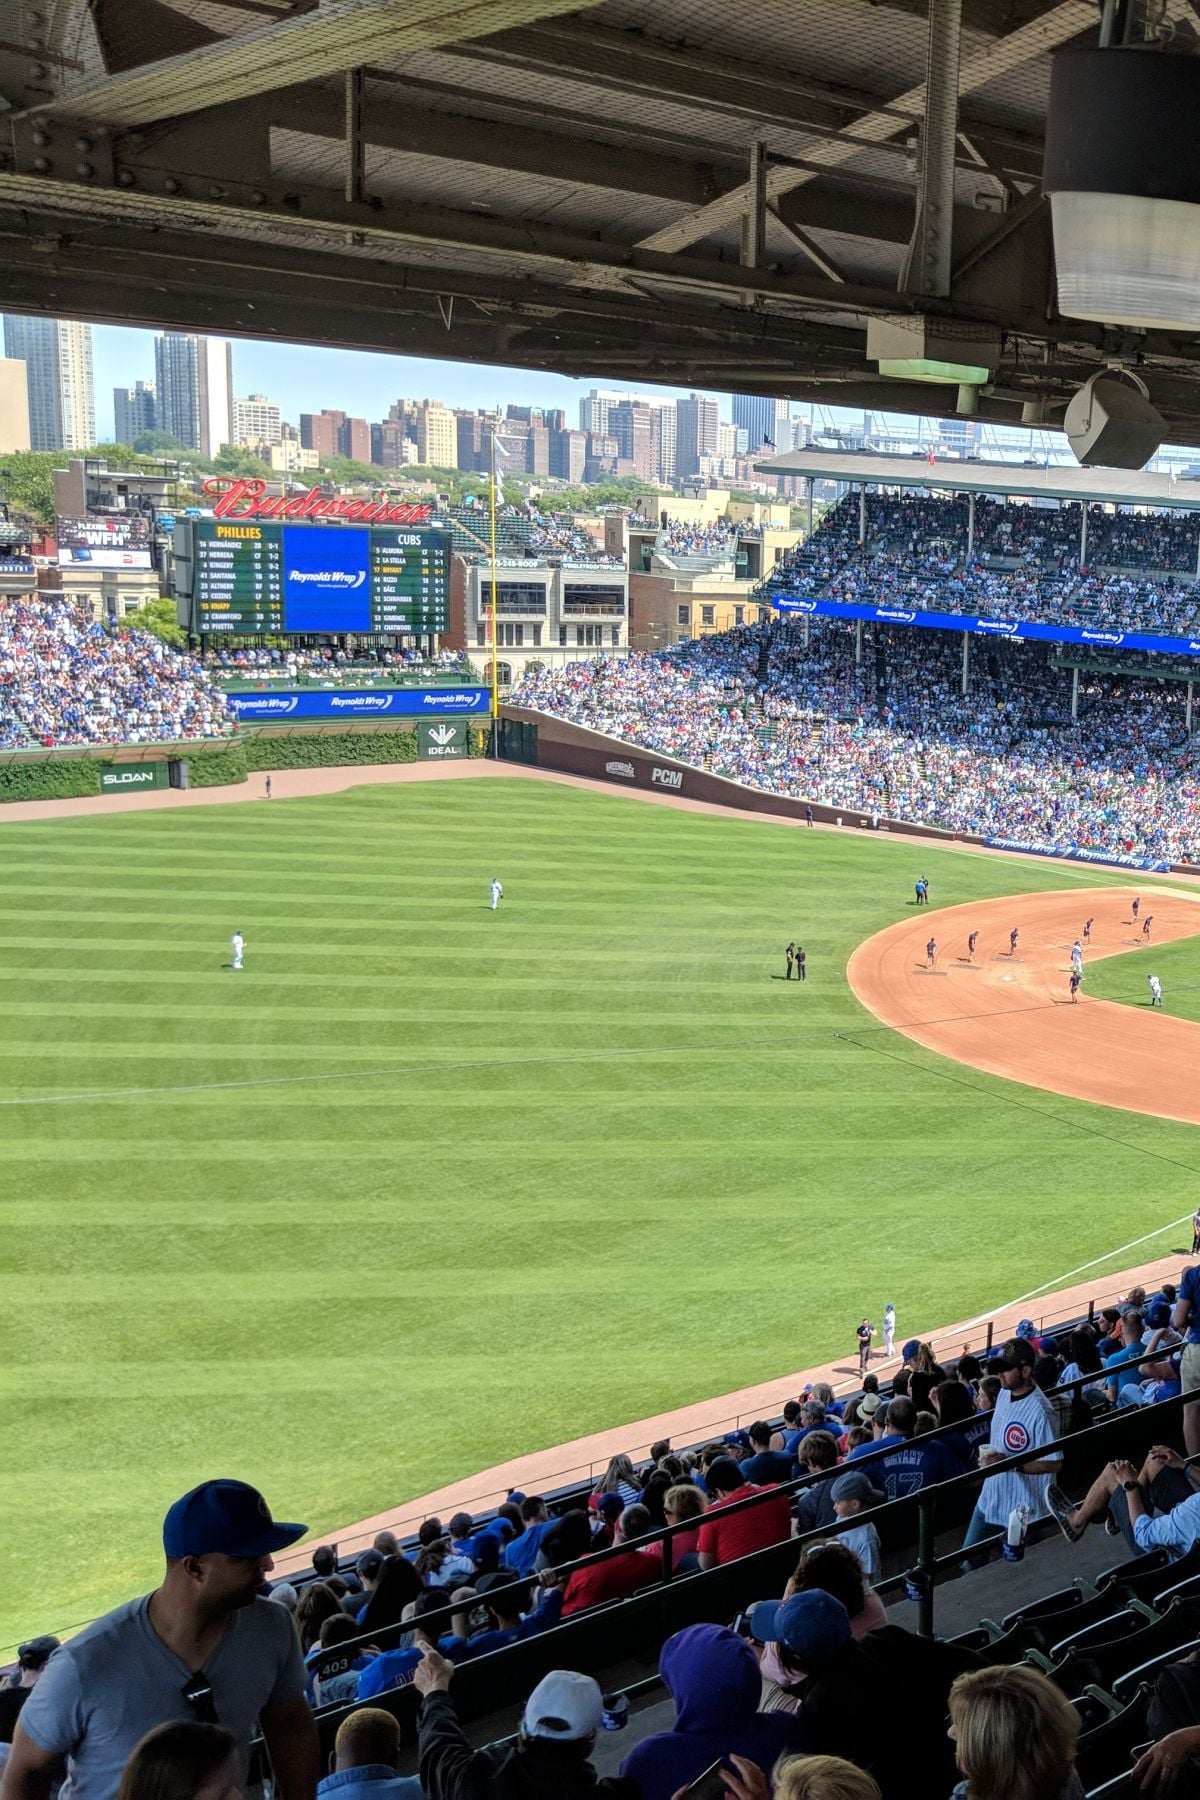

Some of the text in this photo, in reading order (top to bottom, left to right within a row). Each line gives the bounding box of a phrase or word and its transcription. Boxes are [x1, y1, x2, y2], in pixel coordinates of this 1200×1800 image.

[203, 478, 432, 522] Budweiser
[216, 526, 262, 539] PHILLIES
[397, 533, 422, 545] CUBS
[290, 570, 357, 584] Reynolds Wrap
[269, 699, 290, 709] Wrap
[331, 695, 385, 708] Reynolds Wrap
[424, 694, 474, 705] Reynolds Wrap
[428, 747, 458, 755] IDEAL
[103, 771, 153, 785] SLOAN
[652, 767, 683, 785] PCM
[1032, 843, 1057, 855] Wrap
[1076, 850, 1144, 867] Reynolds Wrap
[322, 1658, 349, 1676] 403
